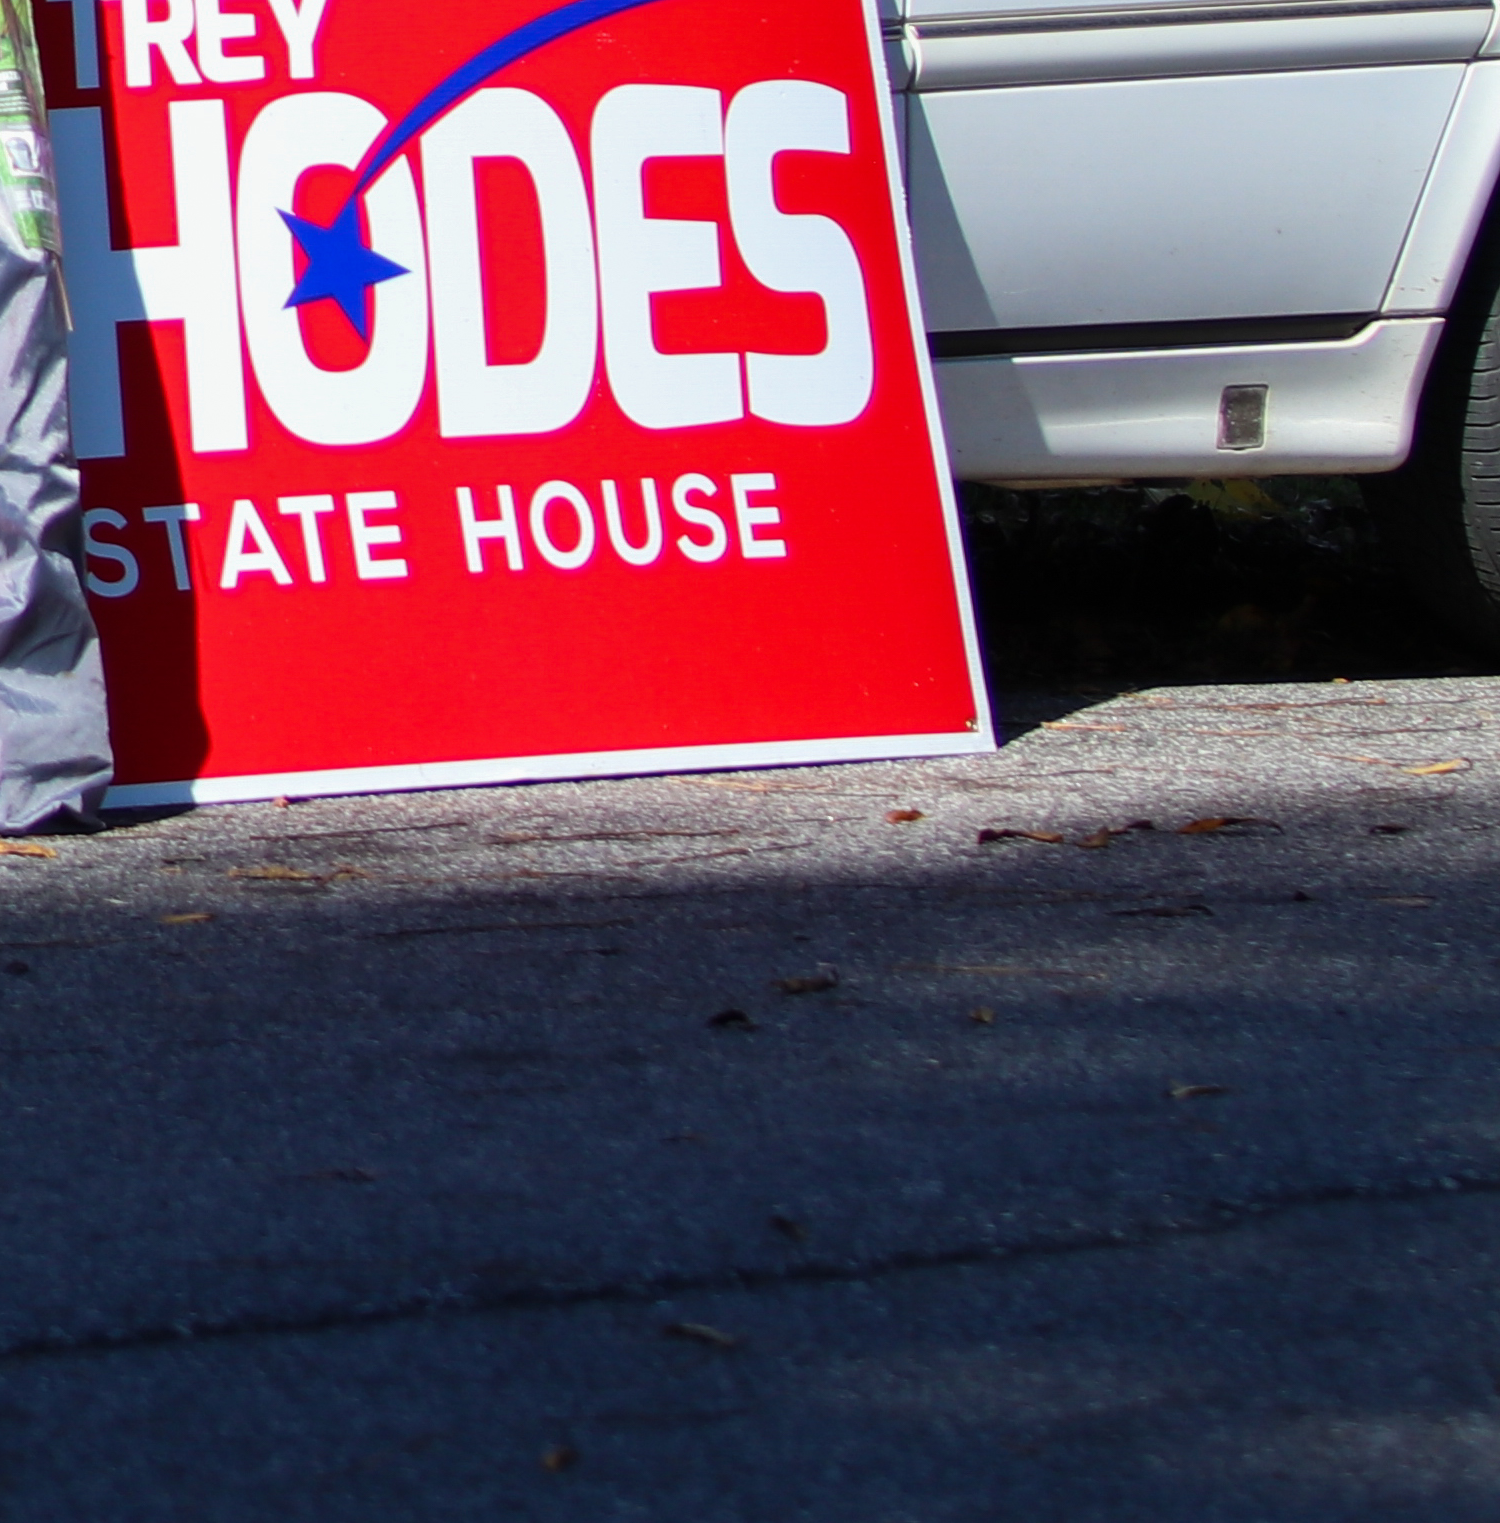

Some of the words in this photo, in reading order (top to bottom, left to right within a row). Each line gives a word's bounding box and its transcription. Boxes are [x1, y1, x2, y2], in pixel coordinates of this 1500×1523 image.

[47, 79, 875, 459] HODES
[82, 490, 409, 599] STATE
[456, 472, 788, 575] HOUSE
